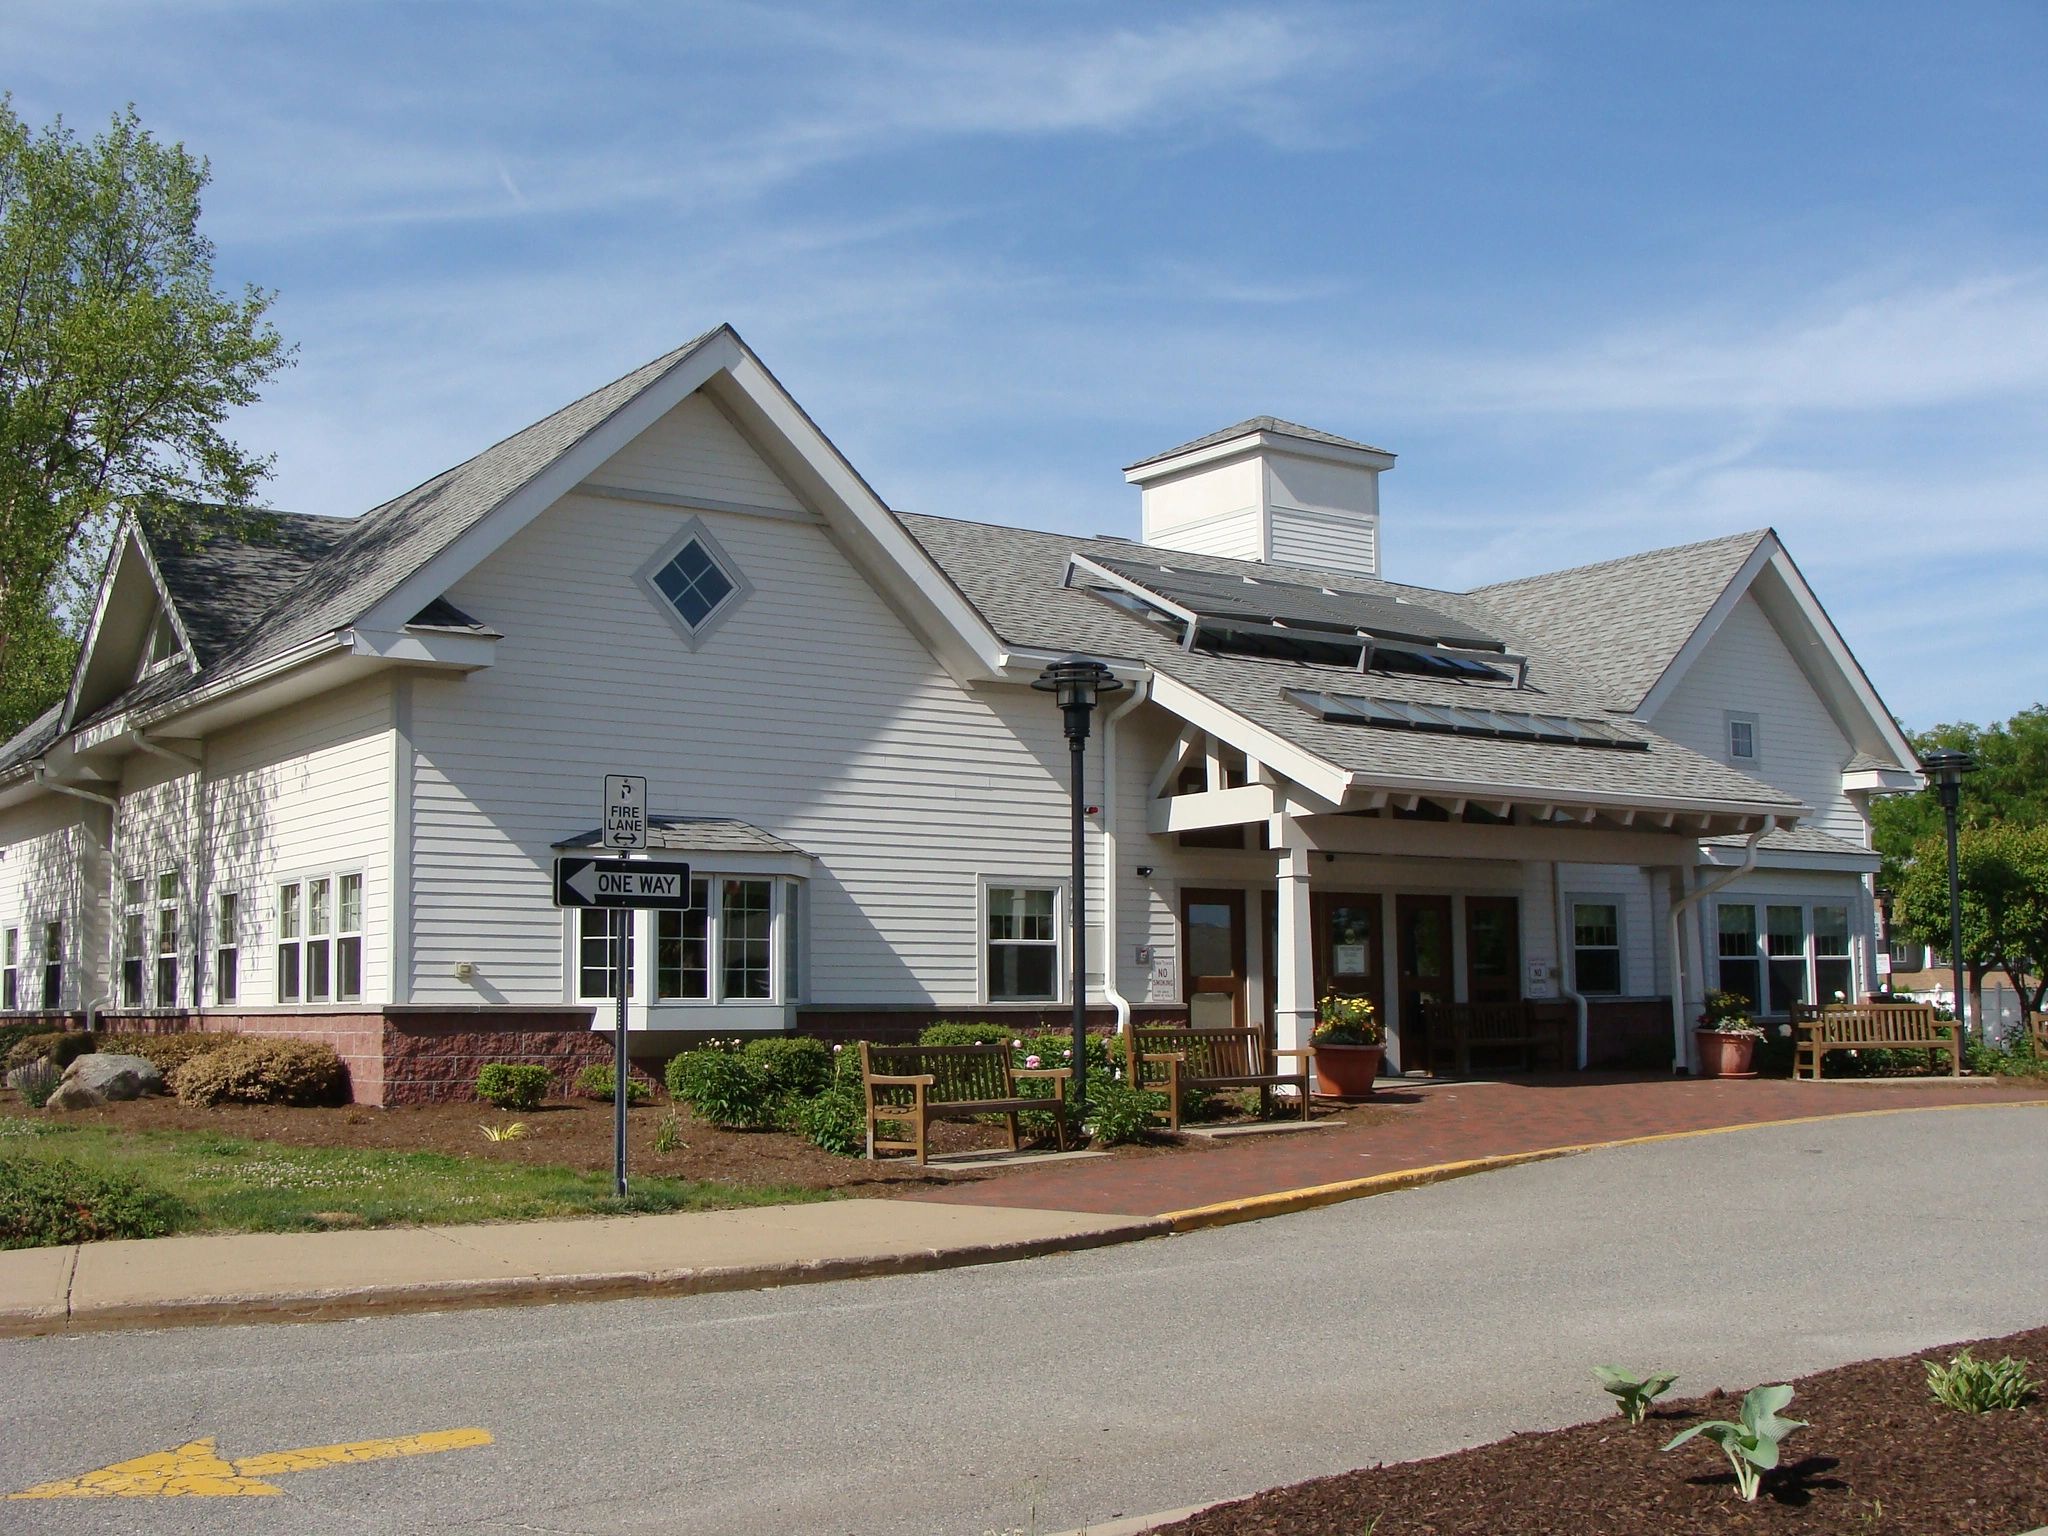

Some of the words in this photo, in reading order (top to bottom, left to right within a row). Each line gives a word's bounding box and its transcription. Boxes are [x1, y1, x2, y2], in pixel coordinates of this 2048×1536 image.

[611, 806, 639, 818] FIRE
[608, 819, 642, 831] LANE
[598, 874, 632, 892] ONE
[640, 876, 675, 894] WAY
[1158, 968, 1168, 978] NO
